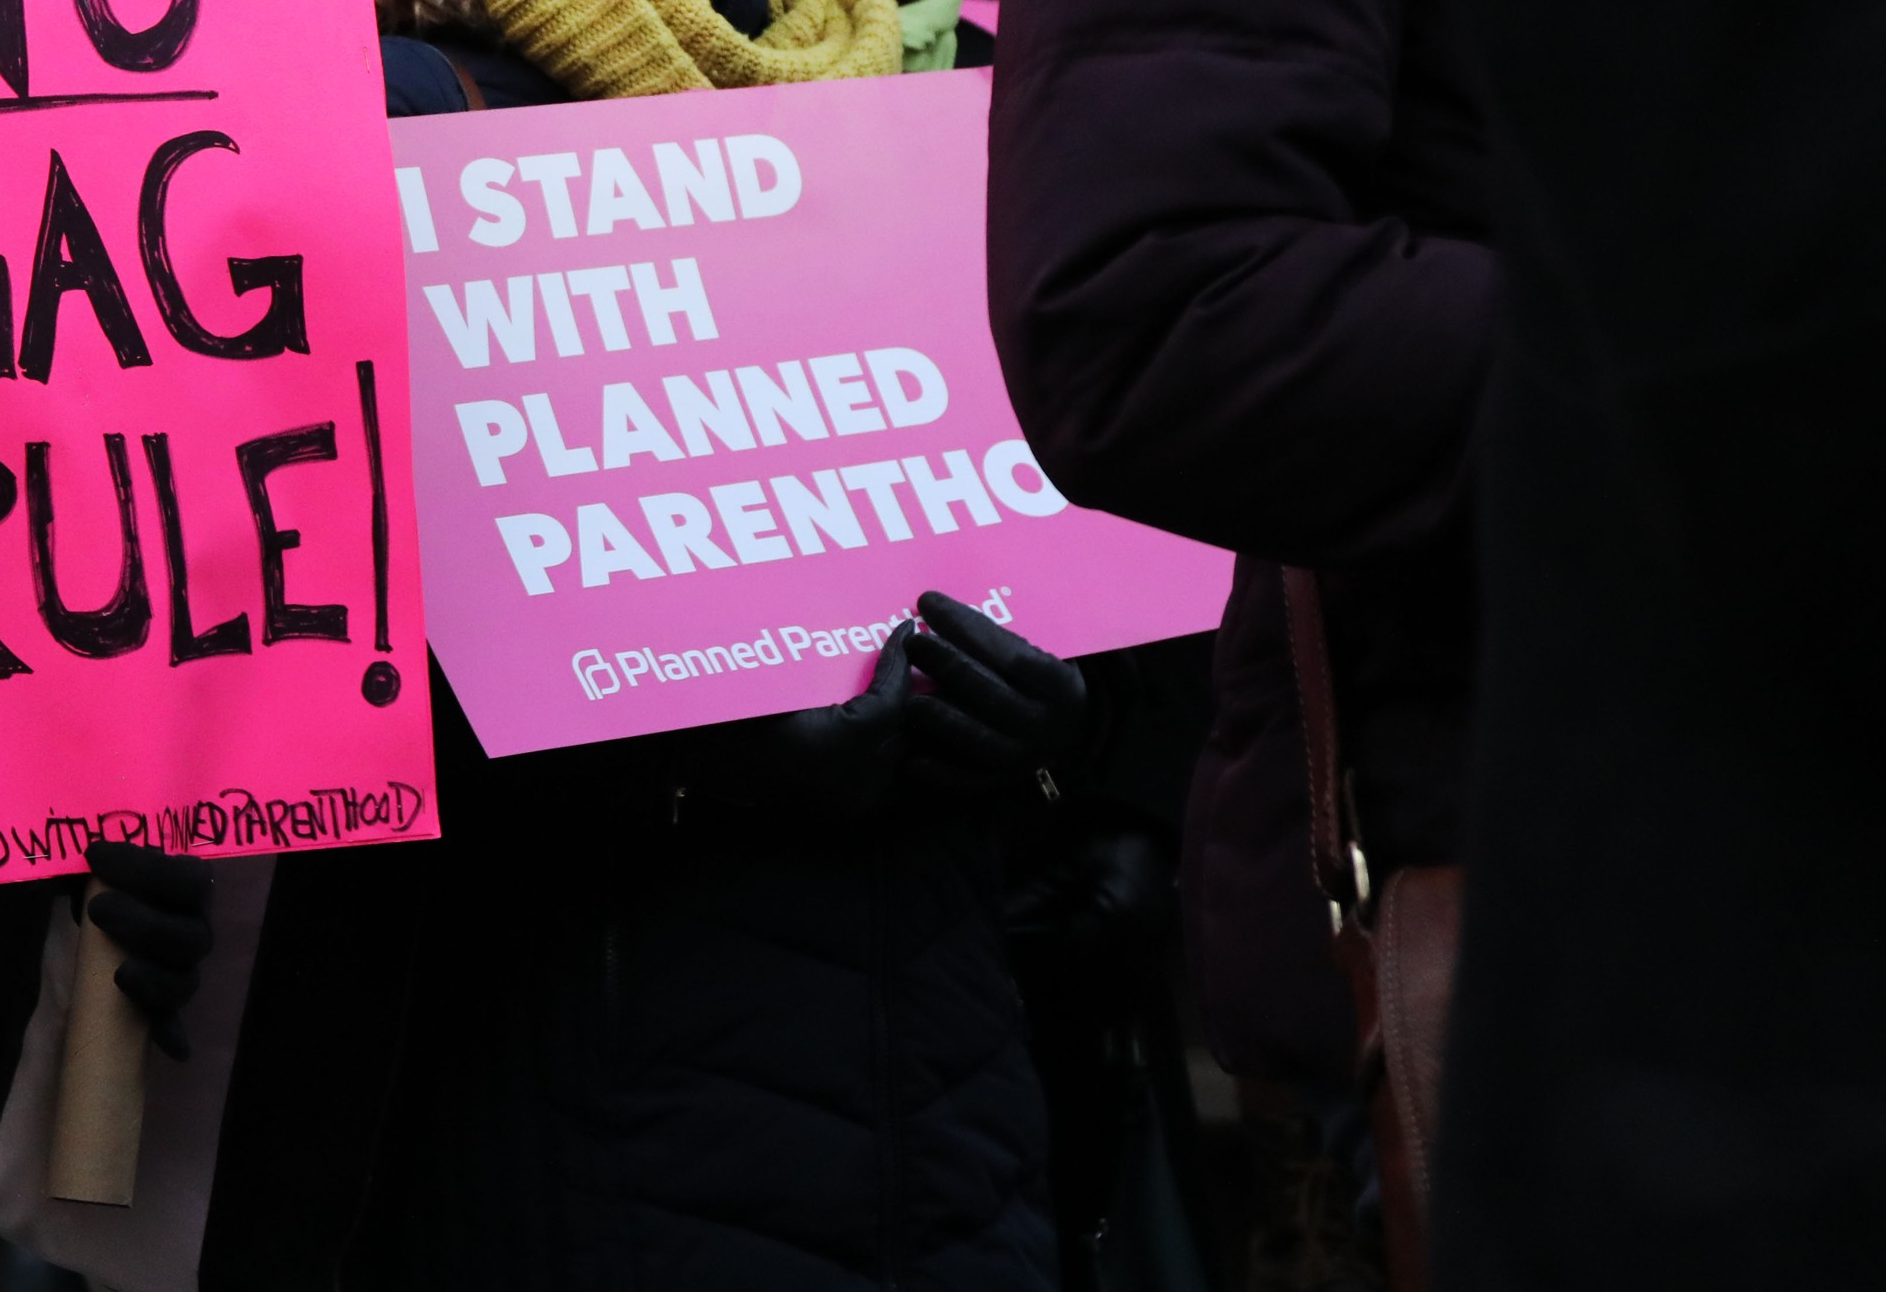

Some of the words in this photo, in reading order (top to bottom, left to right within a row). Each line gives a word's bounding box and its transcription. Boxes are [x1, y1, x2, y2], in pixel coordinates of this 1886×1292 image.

[394, 167, 440, 254] I
[459, 133, 803, 248] STAND
[423, 257, 720, 370] WITH
[454, 346, 950, 488] PLANNED
[494, 438, 1071, 597] PARENTHO
[615, 629, 785, 689] Planned
[778, 587, 1013, 661] Parenthd
